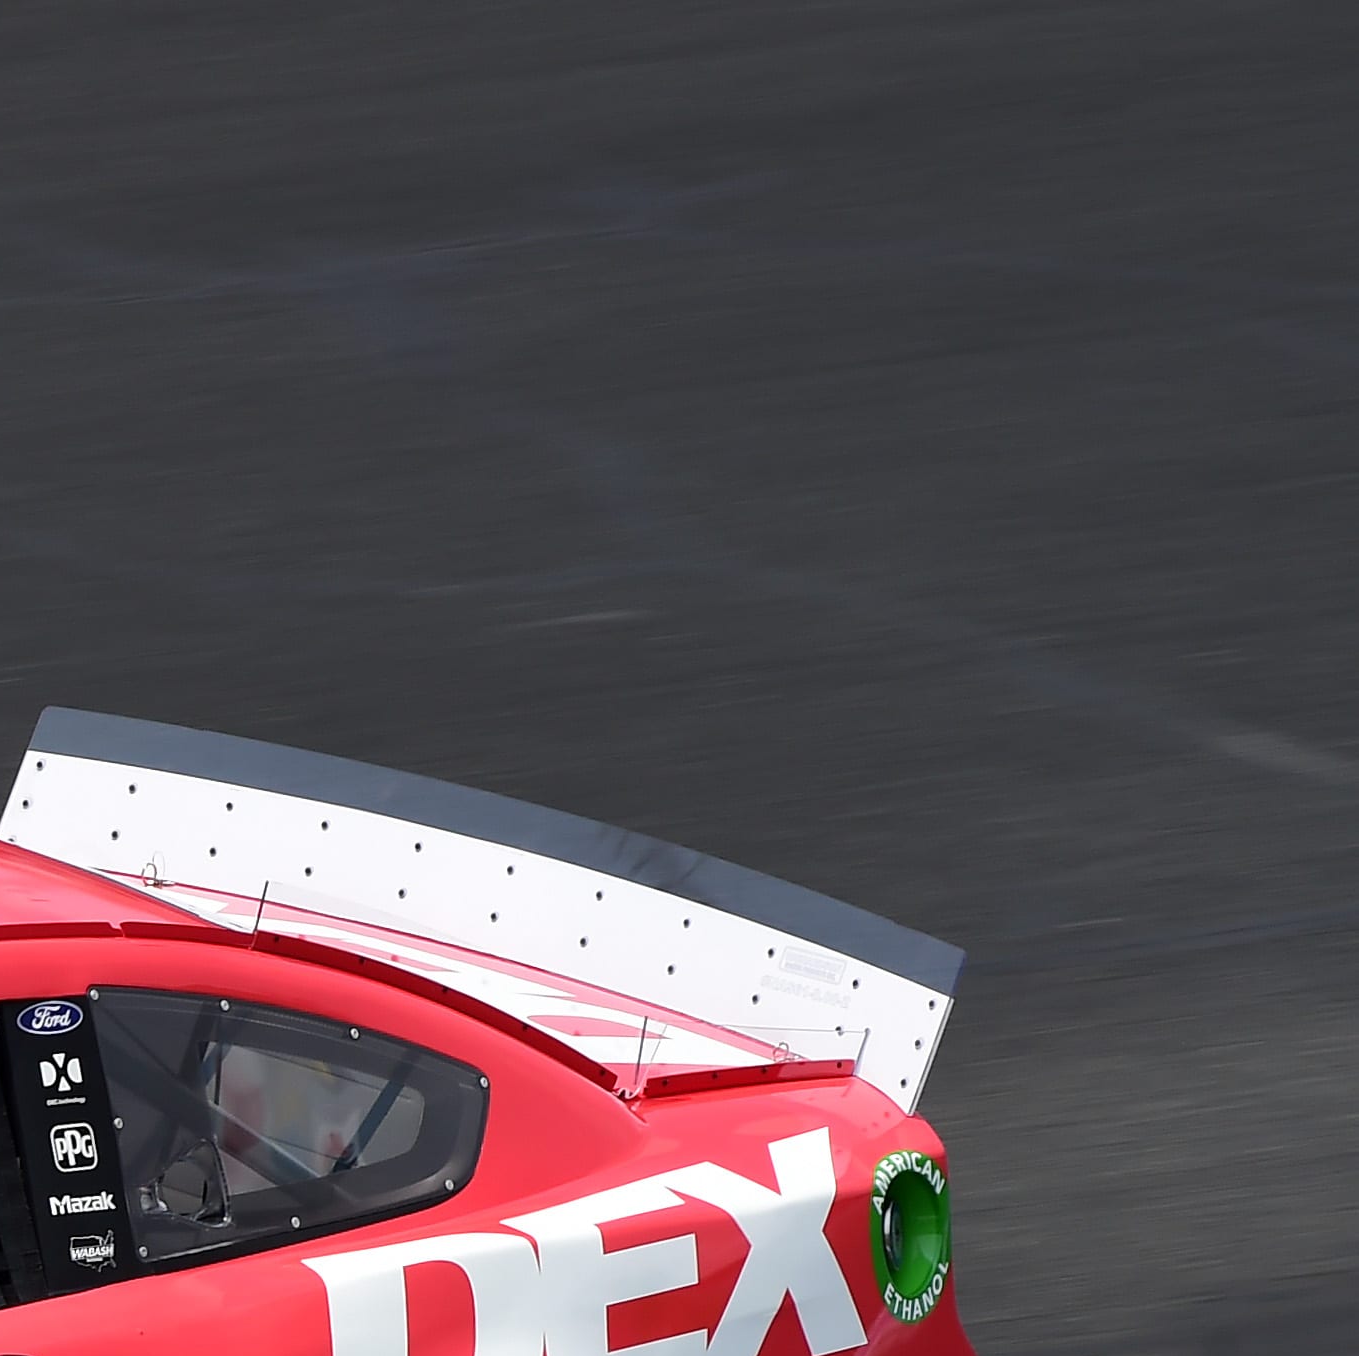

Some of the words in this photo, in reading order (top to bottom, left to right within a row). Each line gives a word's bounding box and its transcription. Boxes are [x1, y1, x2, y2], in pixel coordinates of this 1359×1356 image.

[30, 1003, 73, 1031] Ford
[54, 1130, 94, 1166] PPG
[873, 1151, 945, 1215] AMERICAN
[49, 1191, 116, 1216] Mazak
[71, 1245, 114, 1260] WABASH
[883, 1262, 950, 1321] ETHANOL
